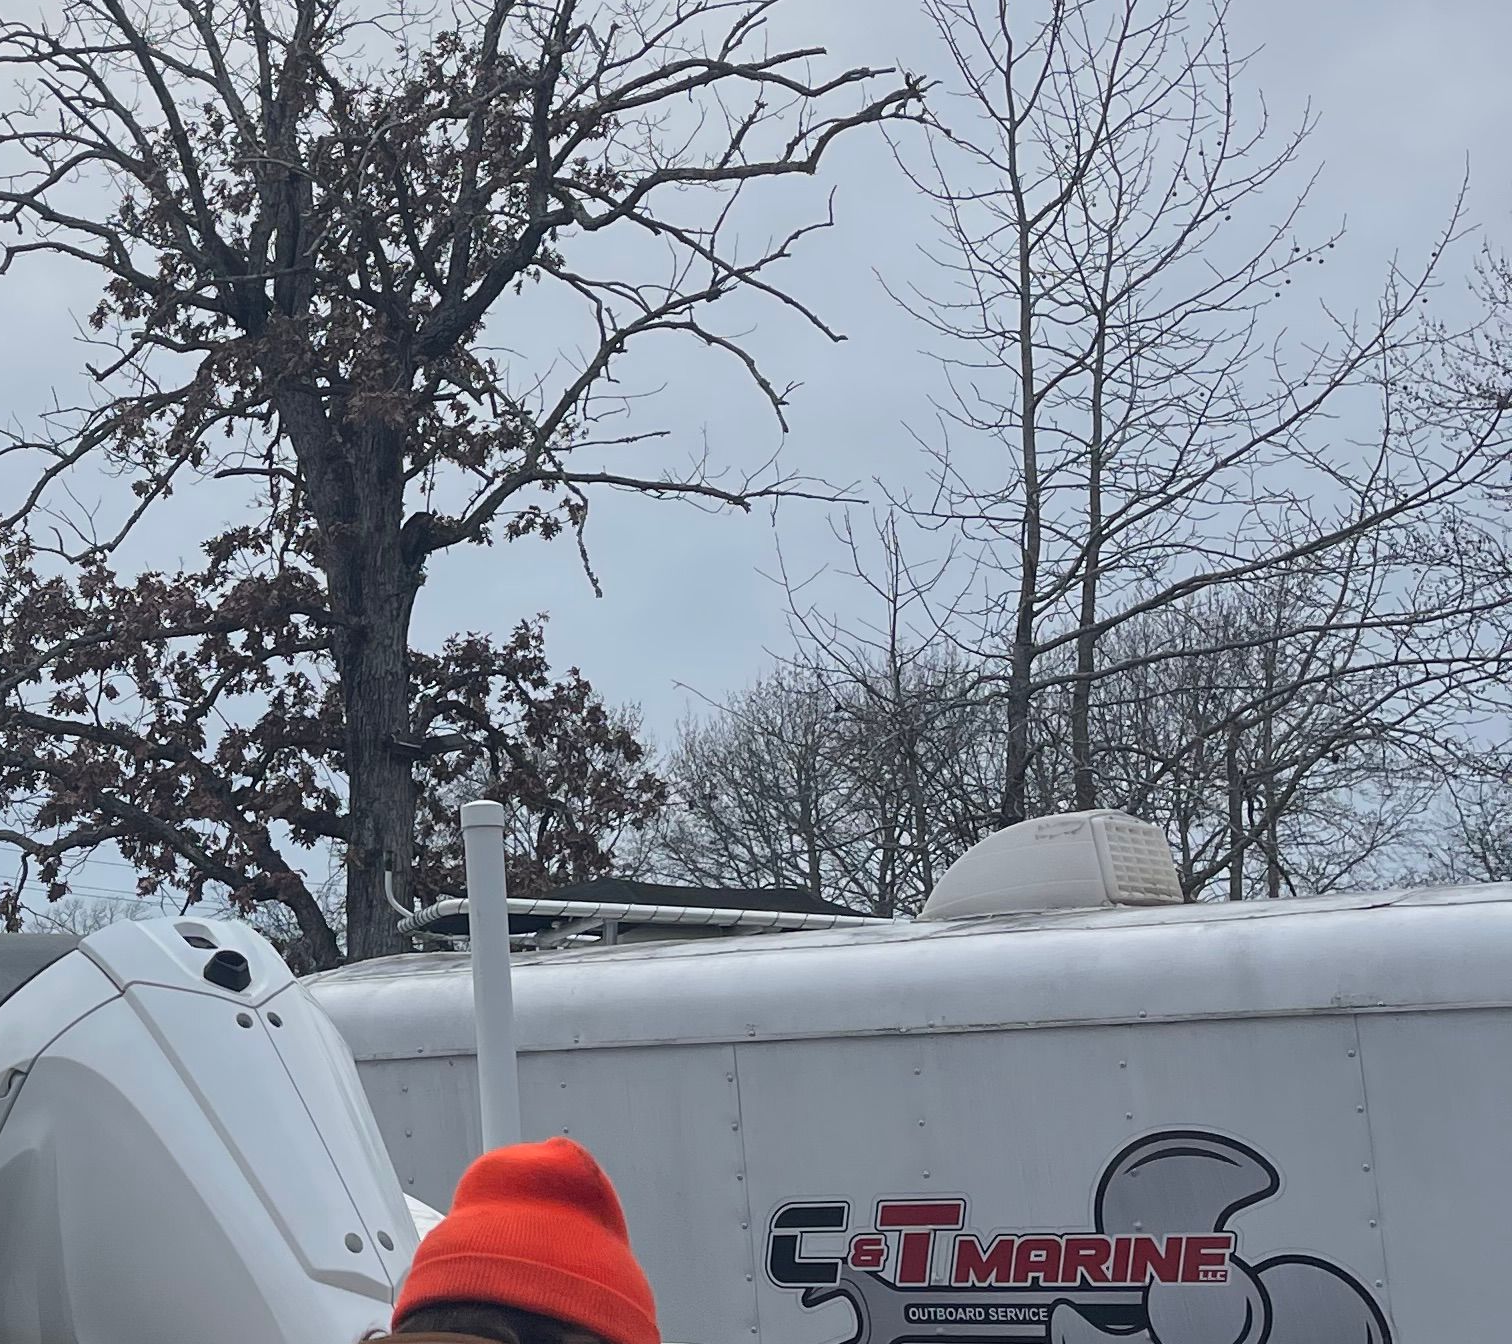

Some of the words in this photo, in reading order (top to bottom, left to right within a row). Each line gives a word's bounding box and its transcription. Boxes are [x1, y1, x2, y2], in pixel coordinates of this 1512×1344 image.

[952, 1235, 1232, 1284] MARINE
[1199, 1271, 1226, 1281] LLC
[908, 1307, 986, 1321] OUTBOARD
[988, 1307, 1049, 1321] SERVICE
